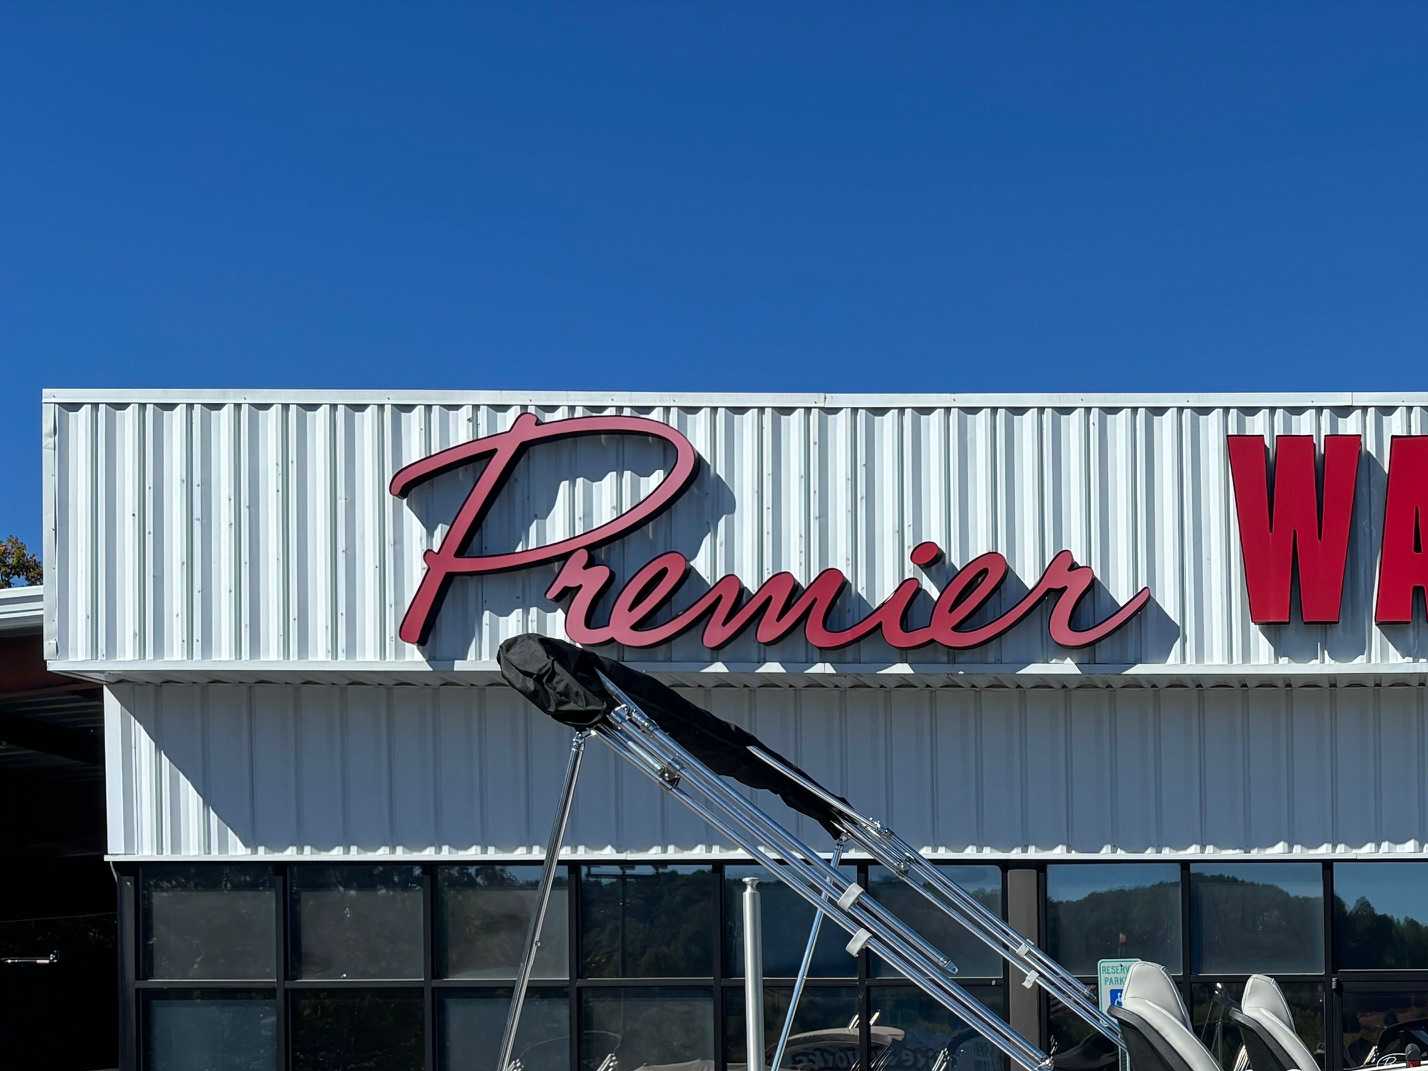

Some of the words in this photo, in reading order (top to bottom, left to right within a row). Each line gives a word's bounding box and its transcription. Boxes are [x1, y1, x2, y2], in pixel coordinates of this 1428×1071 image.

[389, 411, 1151, 651] Premier
[1101, 966, 1129, 974] RESERV
[1104, 976, 1126, 985] PARK
